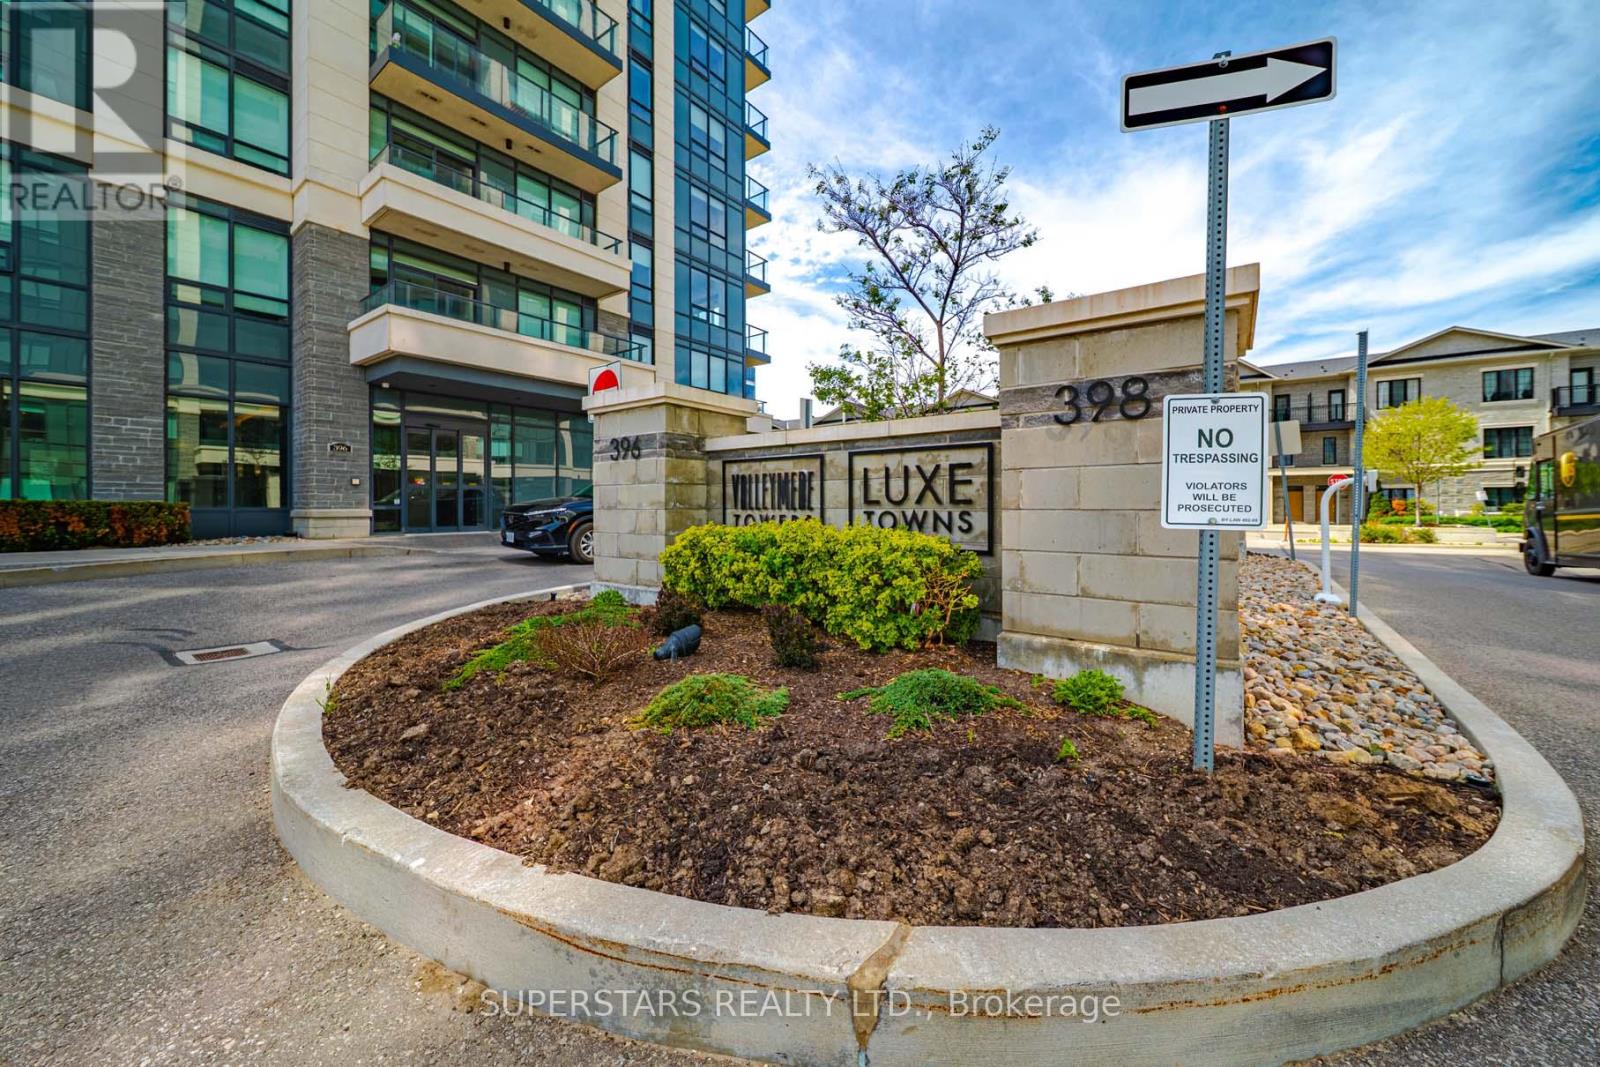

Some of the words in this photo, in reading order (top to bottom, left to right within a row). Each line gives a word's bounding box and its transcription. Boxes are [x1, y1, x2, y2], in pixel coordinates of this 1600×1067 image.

[1053, 376, 1151, 425] 398
[1172, 405, 1208, 414] PRIVATE
[1210, 404, 1259, 413] PROPERTY
[1197, 428, 1234, 448] NO
[610, 435, 641, 461] 396
[1172, 453, 1258, 463] TRESPASSING
[863, 462, 973, 505] LUXE
[1185, 482, 1248, 491] VIOLATORS
[1192, 493, 1218, 501] WILL
[1221, 493, 1237, 501] BE
[1177, 504, 1252, 513] PROSECUTED
[863, 510, 973, 534] TOWNS
